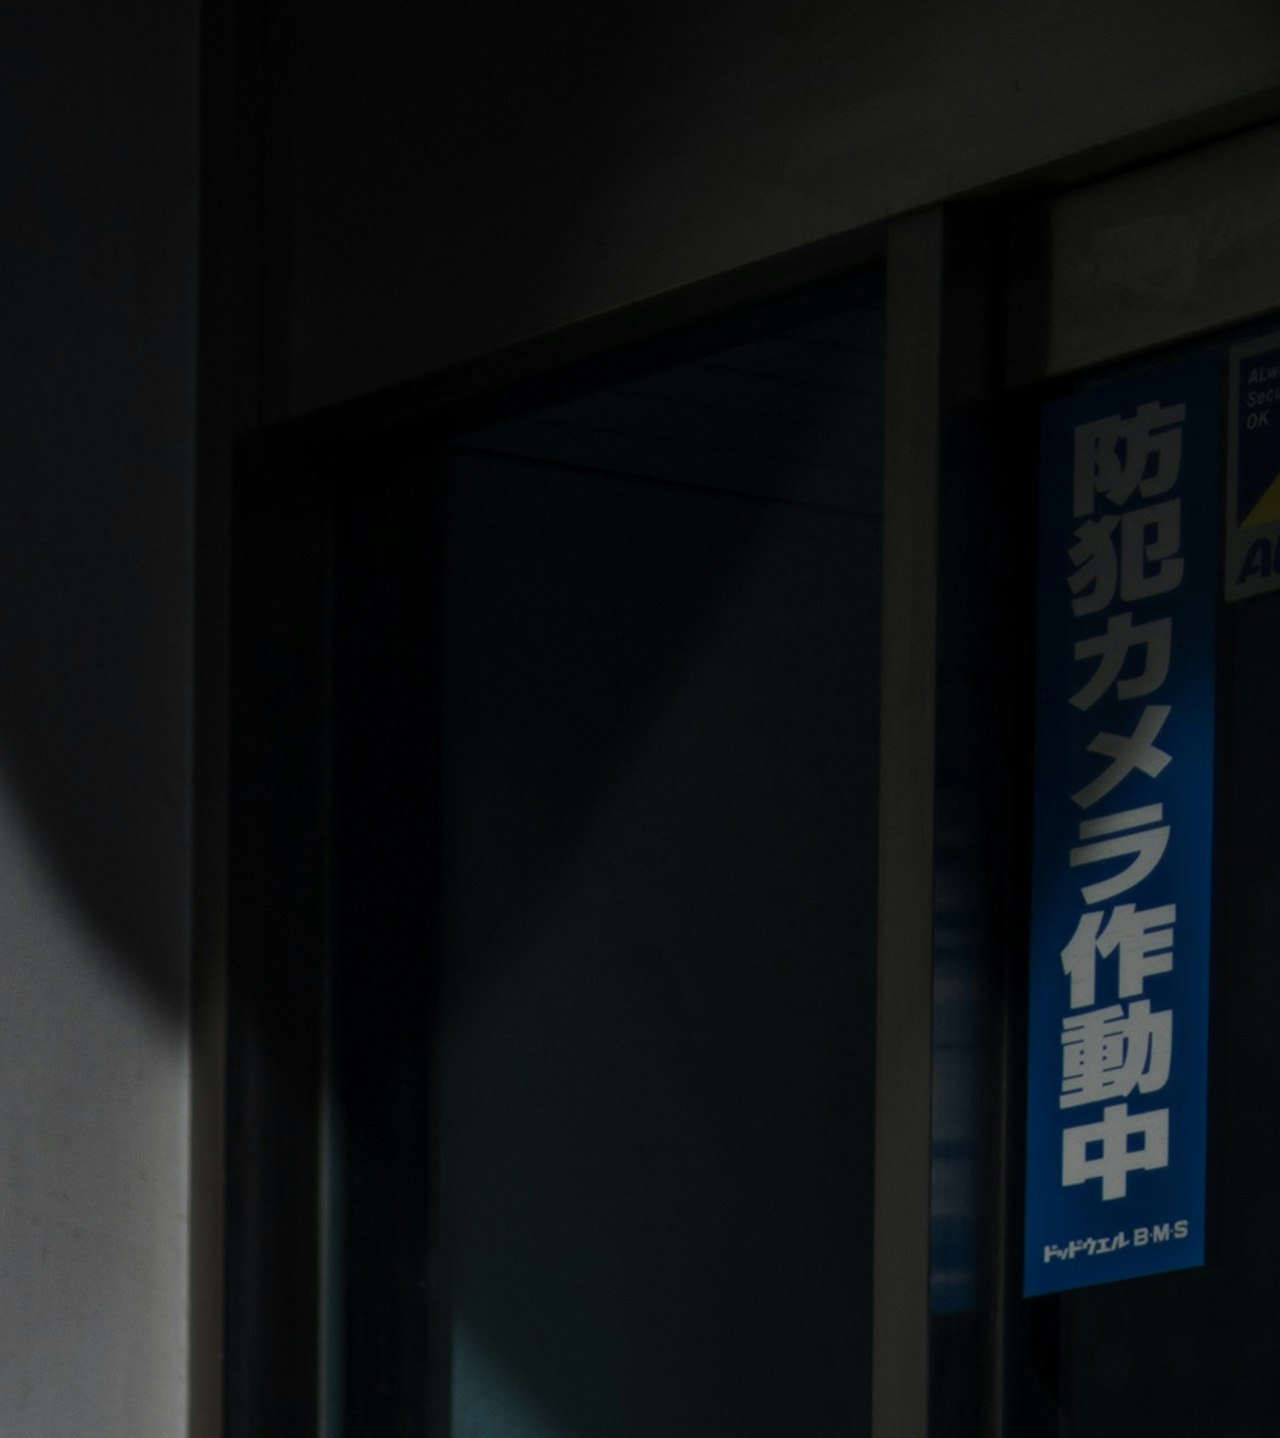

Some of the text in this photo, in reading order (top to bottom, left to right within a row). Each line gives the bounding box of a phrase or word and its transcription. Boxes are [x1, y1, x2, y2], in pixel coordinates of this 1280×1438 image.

[1246, 408, 1269, 430] OK
[1060, 400, 1186, 1200] 防犯カメラ作動中
